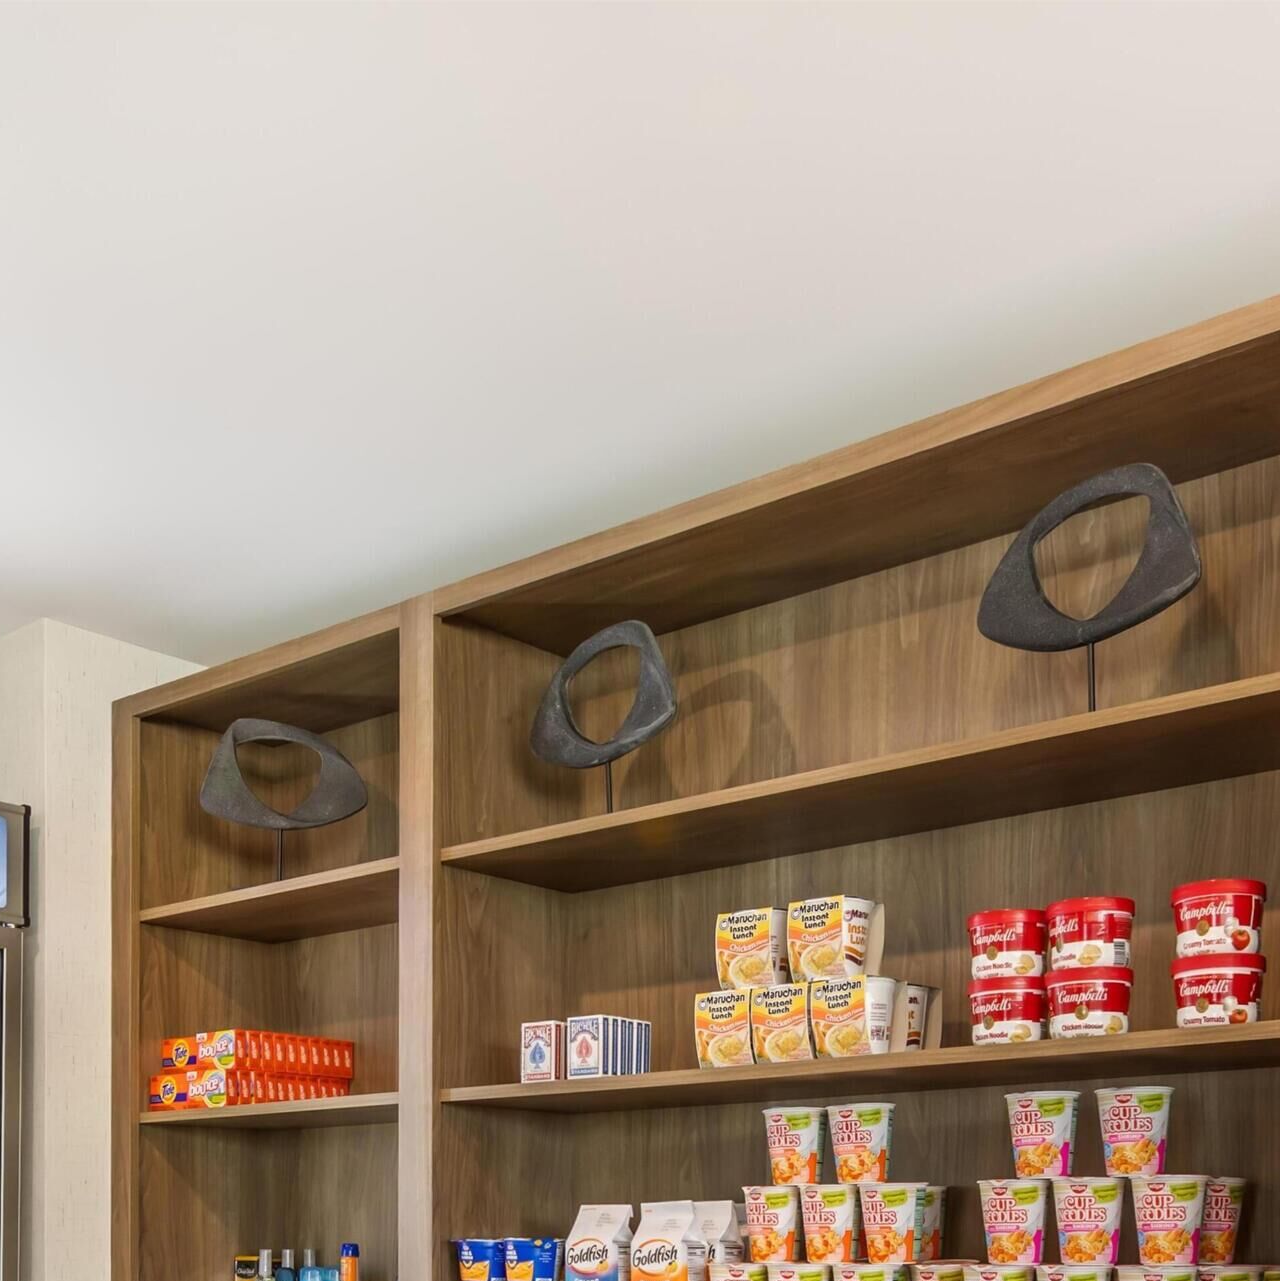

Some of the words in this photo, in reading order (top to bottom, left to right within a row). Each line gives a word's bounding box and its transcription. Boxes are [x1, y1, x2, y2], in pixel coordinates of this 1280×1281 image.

[800, 901, 839, 914] Maruchan
[1180, 902, 1229, 921] Campbell's
[728, 913, 767, 924] Maruchan
[802, 913, 829, 922] Instant
[730, 924, 757, 933] Instant
[733, 931, 753, 940] Lunch
[973, 929, 1016, 946] Campbell's
[763, 987, 803, 999] Maruchan
[822, 980, 861, 994] Maruchan
[1180, 980, 1228, 997] Campbell's
[706, 994, 745, 1004] Maruchan
[825, 993, 852, 1001] Instant
[1058, 988, 1107, 1003] Campbell's
[709, 1005, 735, 1014] Instant
[765, 999, 792, 1008] Instant
[828, 1000, 849, 1009] Lunch
[712, 1011, 732, 1019] Lunch
[768, 1006, 790, 1014] Lunch
[1014, 1111, 1041, 1124] CUP
[1110, 1106, 1141, 1119] CUP
[768, 1125, 790, 1136] CUP
[835, 1121, 861, 1133] CUP
[804, 1201, 824, 1213] CUP
[864, 1201, 885, 1213] CUP
[988, 1198, 1016, 1210] CUP
[1065, 1196, 1095, 1208] CUP
[1142, 1195, 1174, 1208] CUP
[748, 1203, 767, 1214] CUP
[567, 1245, 608, 1265] Goldfish
[633, 1246, 677, 1267] Goldfish
